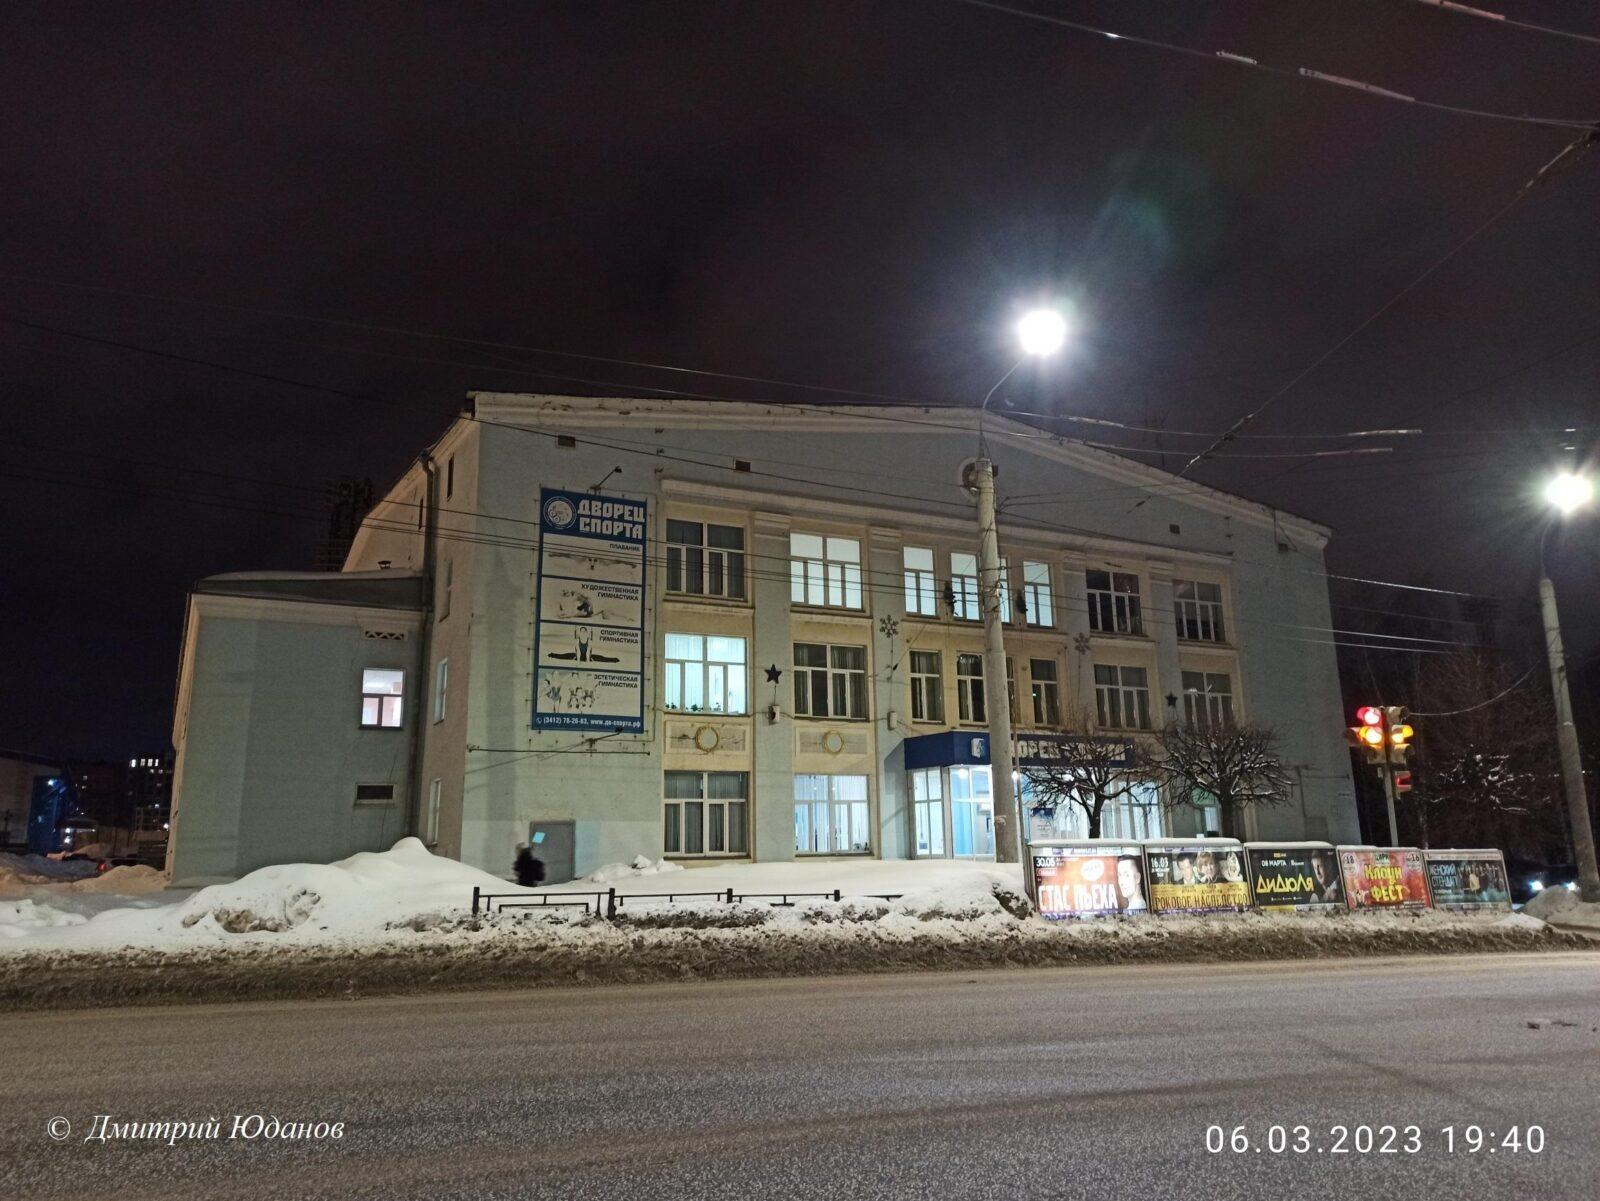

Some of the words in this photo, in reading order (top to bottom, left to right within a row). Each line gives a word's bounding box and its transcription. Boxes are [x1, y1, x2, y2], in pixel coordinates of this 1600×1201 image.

[577, 498, 645, 523] ДВОРЕЦ
[579, 517, 643, 539] СПОРТА
[609, 543, 641, 552] ПЛАВАНИЕ
[581, 584, 639, 594] ХУДОЖЕСТВЕННАЯ
[597, 593, 639, 601] ГИМНАСТИКА
[600, 629, 639, 638] СПОРТИВНАЯ
[599, 636, 639, 644] ГИМНАСТИКА
[594, 674, 638, 682] ЭСТЕТИЧЕСКАЯ
[1151, 857, 1169, 869] 16.03
[1269, 859, 1287, 867] МАРТА
[1038, 884, 1071, 912] СТАС
[1074, 882, 1119, 911] ПЬЕХА
[1370, 884, 1404, 902] ФЕСТ
[1155, 895, 1192, 910] РОКОВОЕ
[1194, 893, 1248, 908] НАСЛЕДСТВО
